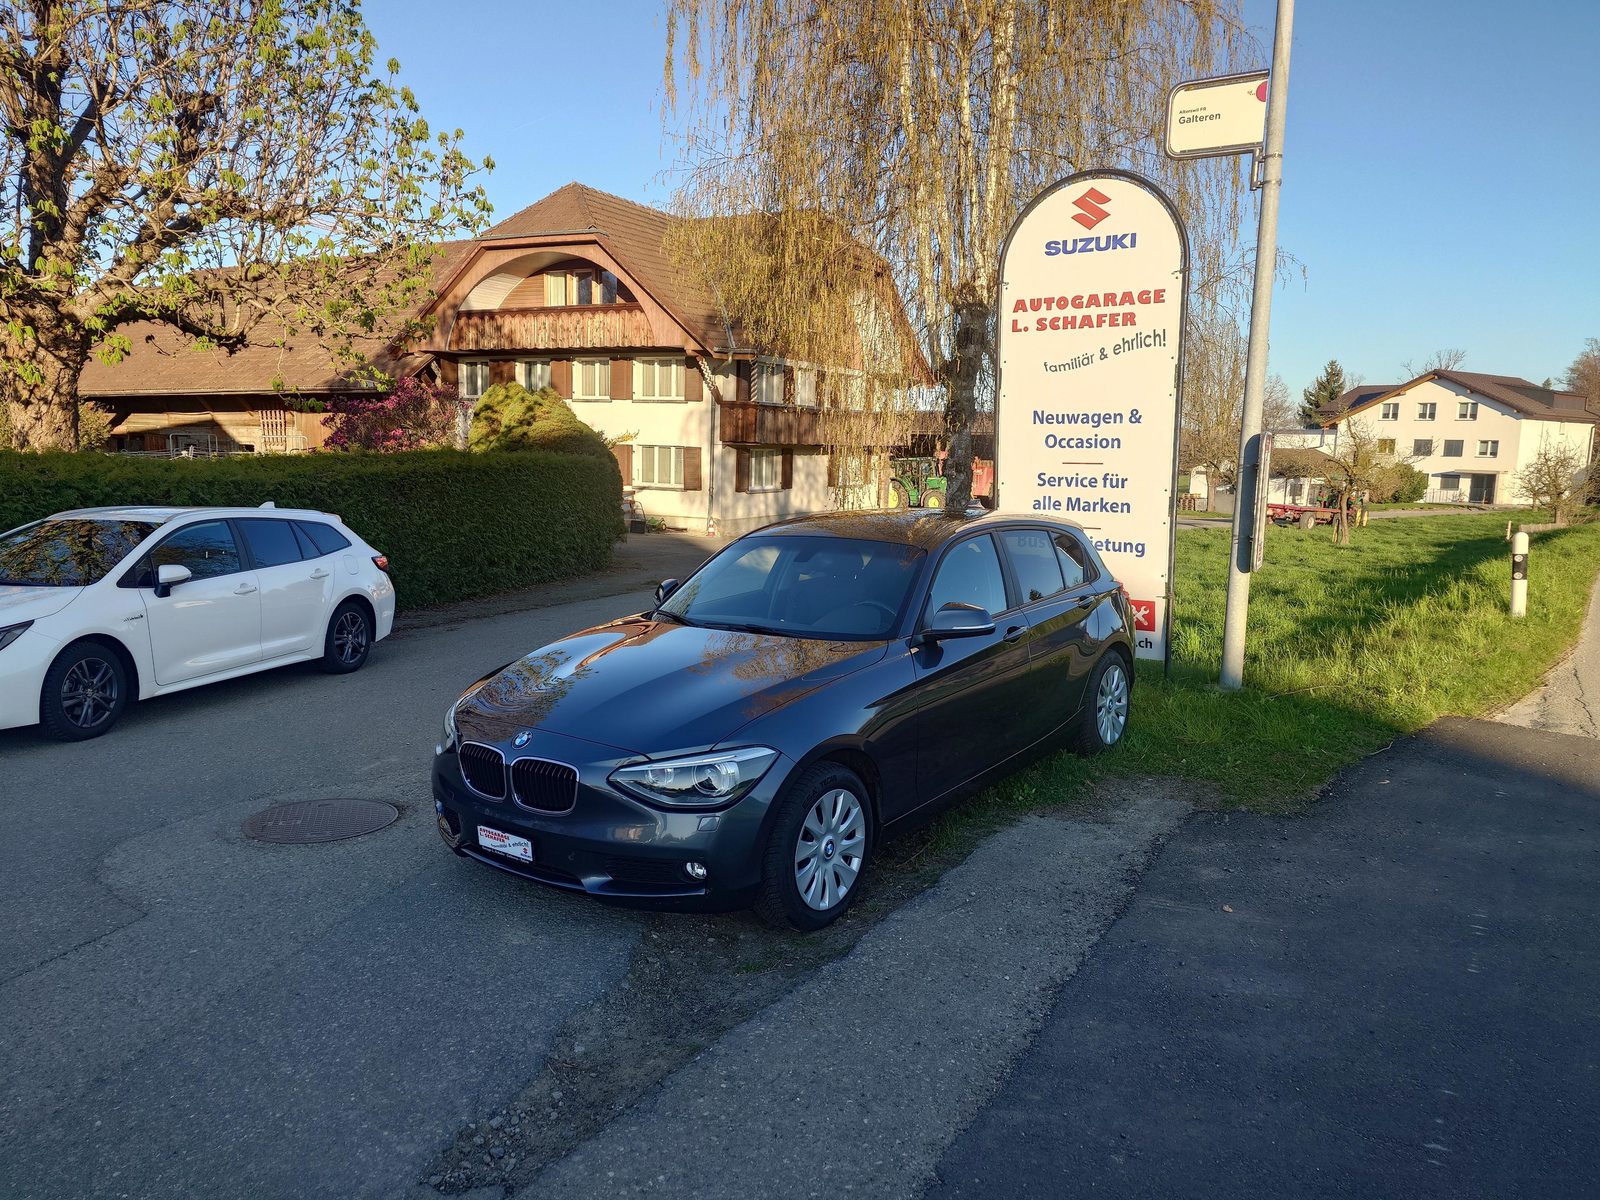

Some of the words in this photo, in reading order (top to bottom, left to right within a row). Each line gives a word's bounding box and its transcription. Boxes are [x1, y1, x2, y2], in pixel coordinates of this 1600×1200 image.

[1178, 113, 1220, 124] Galteren
[1044, 232, 1136, 256] SUZUKI
[1012, 289, 1166, 313] AUTOGARAGE
[1012, 319, 1028, 332] L.
[1036, 312, 1136, 332] SCHAFER
[1044, 352, 1094, 373] familiär
[1099, 348, 1108, 360] &
[1113, 328, 1166, 356] ehrlich!
[1032, 410, 1124, 428] Neuwagen
[1128, 408, 1142, 424] &
[1044, 434, 1121, 449] Occasion
[1037, 472, 1098, 488] Service
[1102, 473, 1128, 488] für
[1032, 496, 1062, 510] alle
[1066, 497, 1131, 514] Marken
